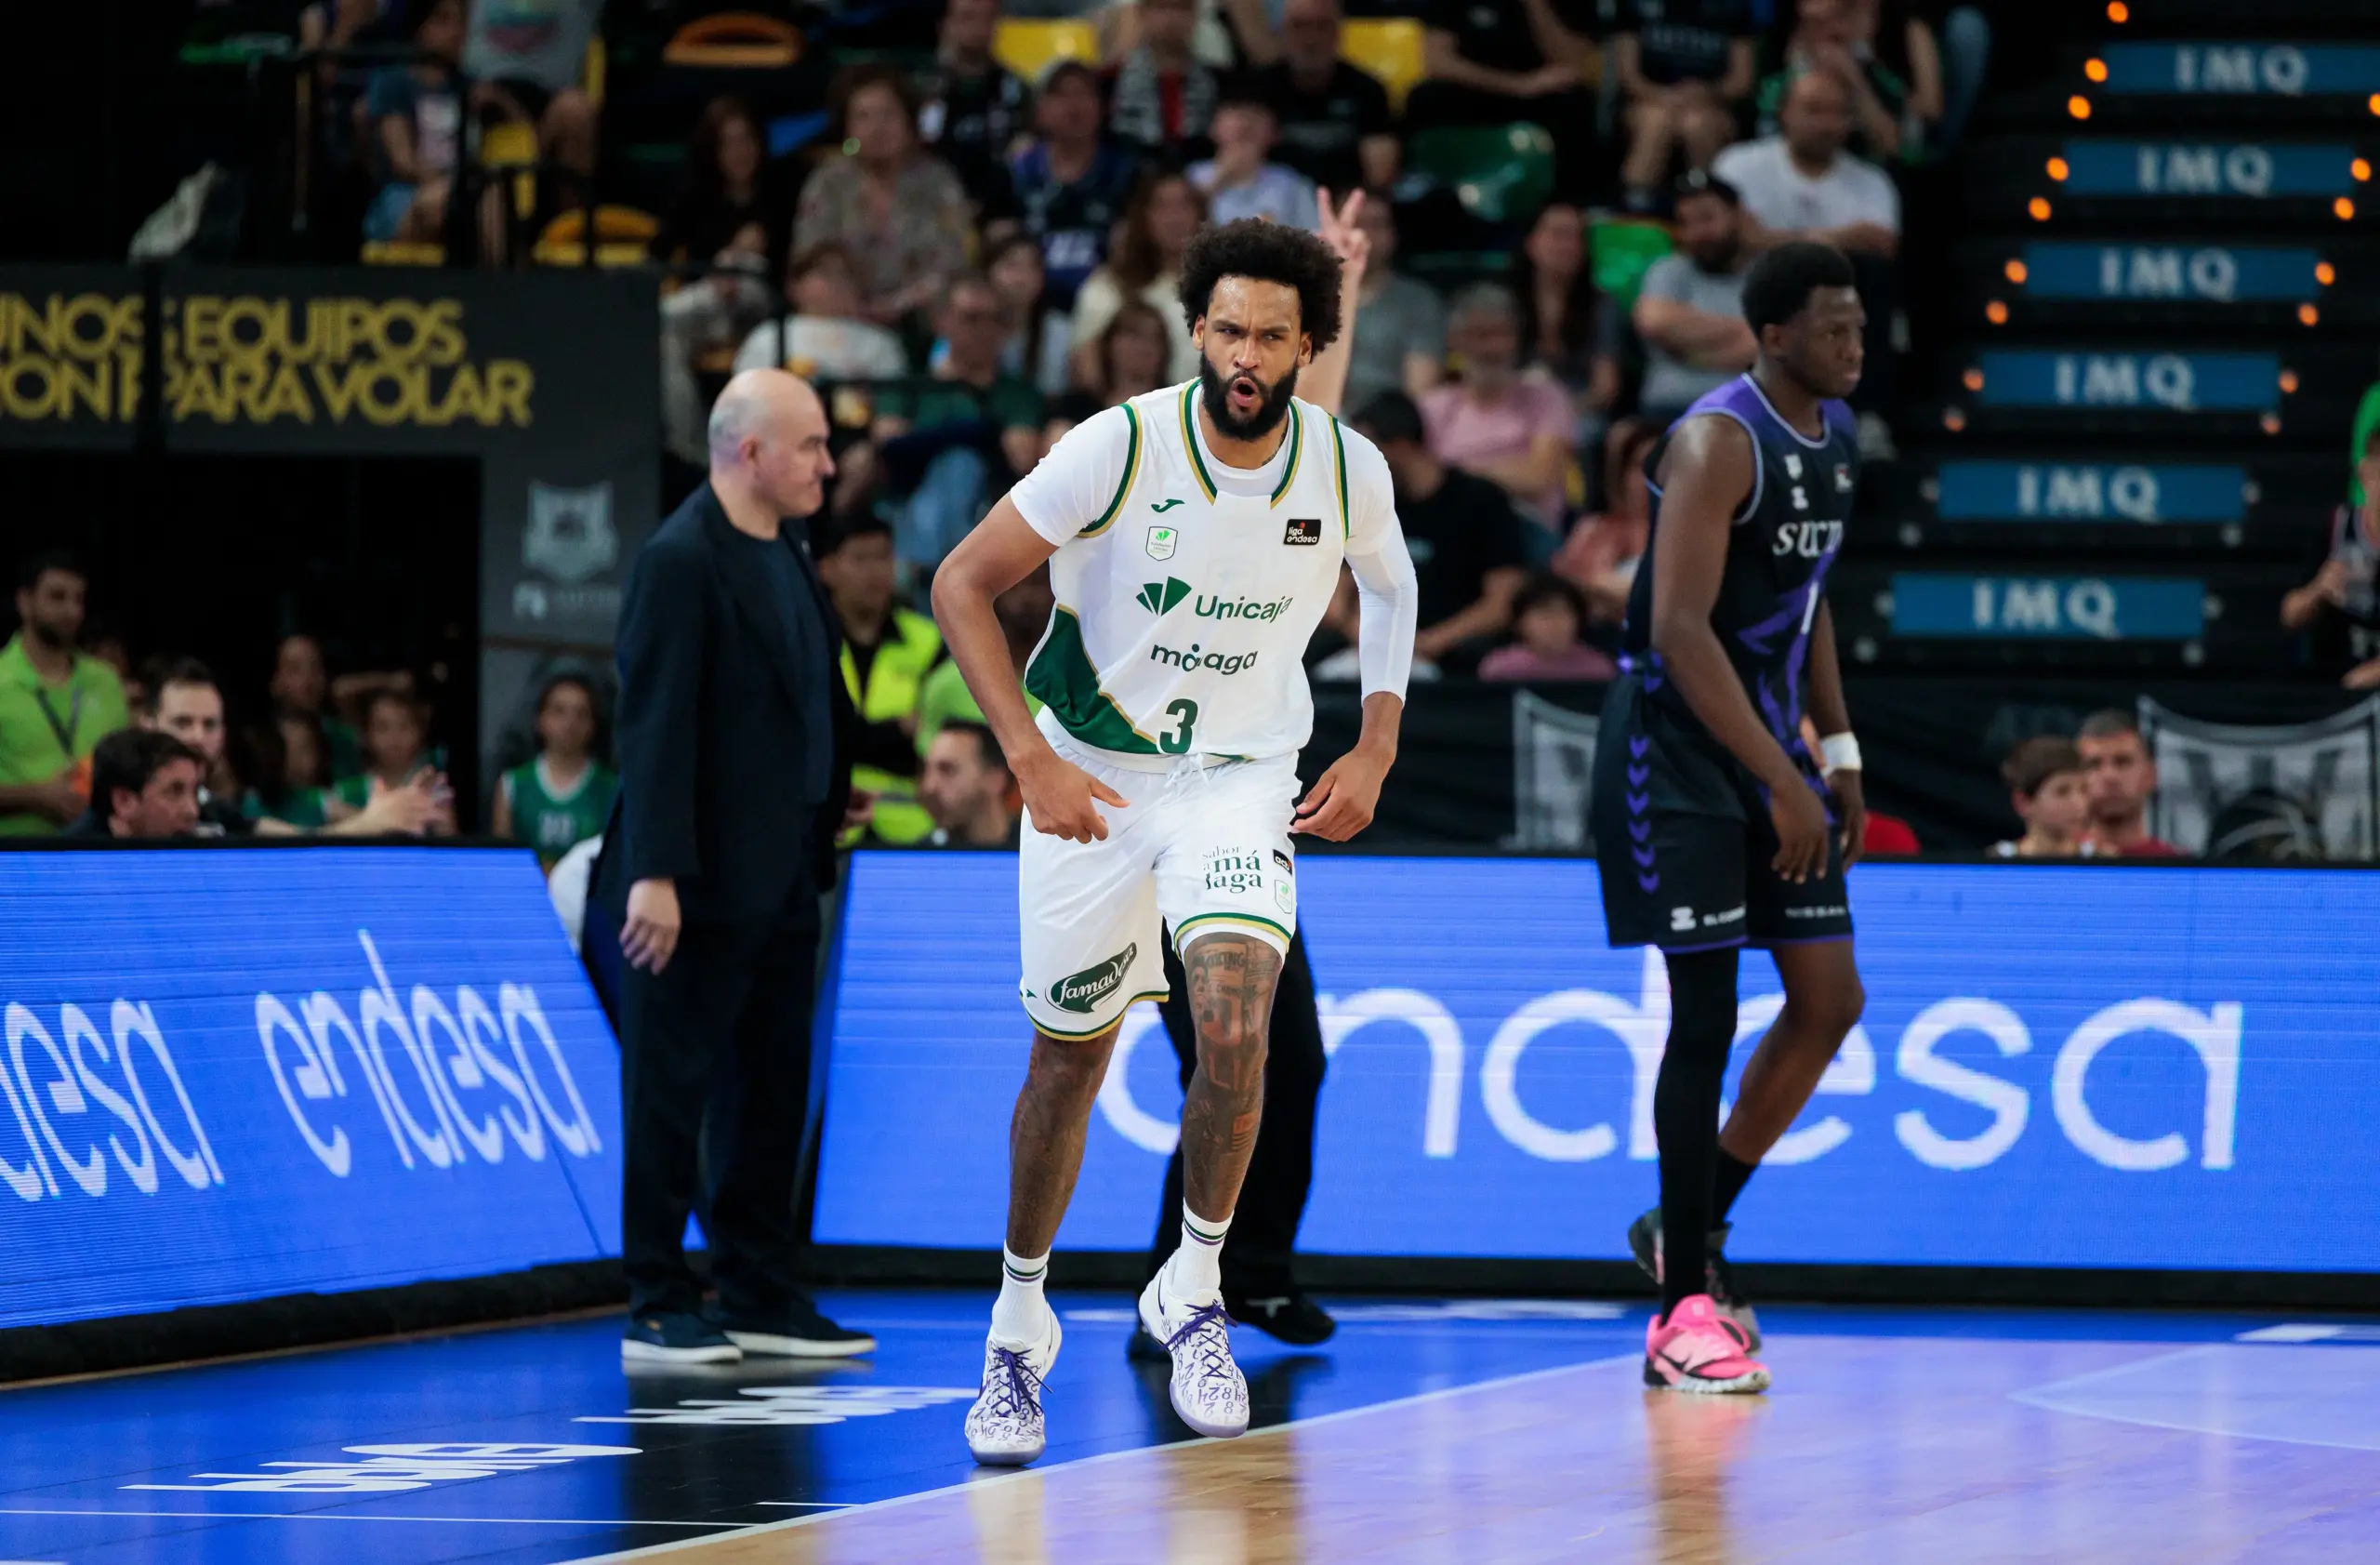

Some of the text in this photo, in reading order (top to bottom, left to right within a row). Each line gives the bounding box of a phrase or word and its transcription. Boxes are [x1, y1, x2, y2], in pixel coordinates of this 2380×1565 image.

[2175, 46, 2308, 96] IMQ
[2139, 145, 2273, 196] IMQ
[2100, 247, 2238, 302] IMQ
[184, 296, 467, 365] EQUIPOS
[312, 360, 535, 427] VOLAR
[2056, 354, 2196, 411] IMQ
[2017, 468, 2162, 524] IMQ
[1287, 535, 1317, 543] endesa
[1289, 526, 1302, 536] liga
[1195, 595, 1293, 623] Unicaja
[1972, 579, 2120, 640] IMQ
[1159, 698, 1198, 754] 3
[1202, 846, 1241, 859] sabor
[1213, 850, 1263, 873] má
[1206, 872, 1263, 894] laga
[254, 929, 602, 1177] endesa
